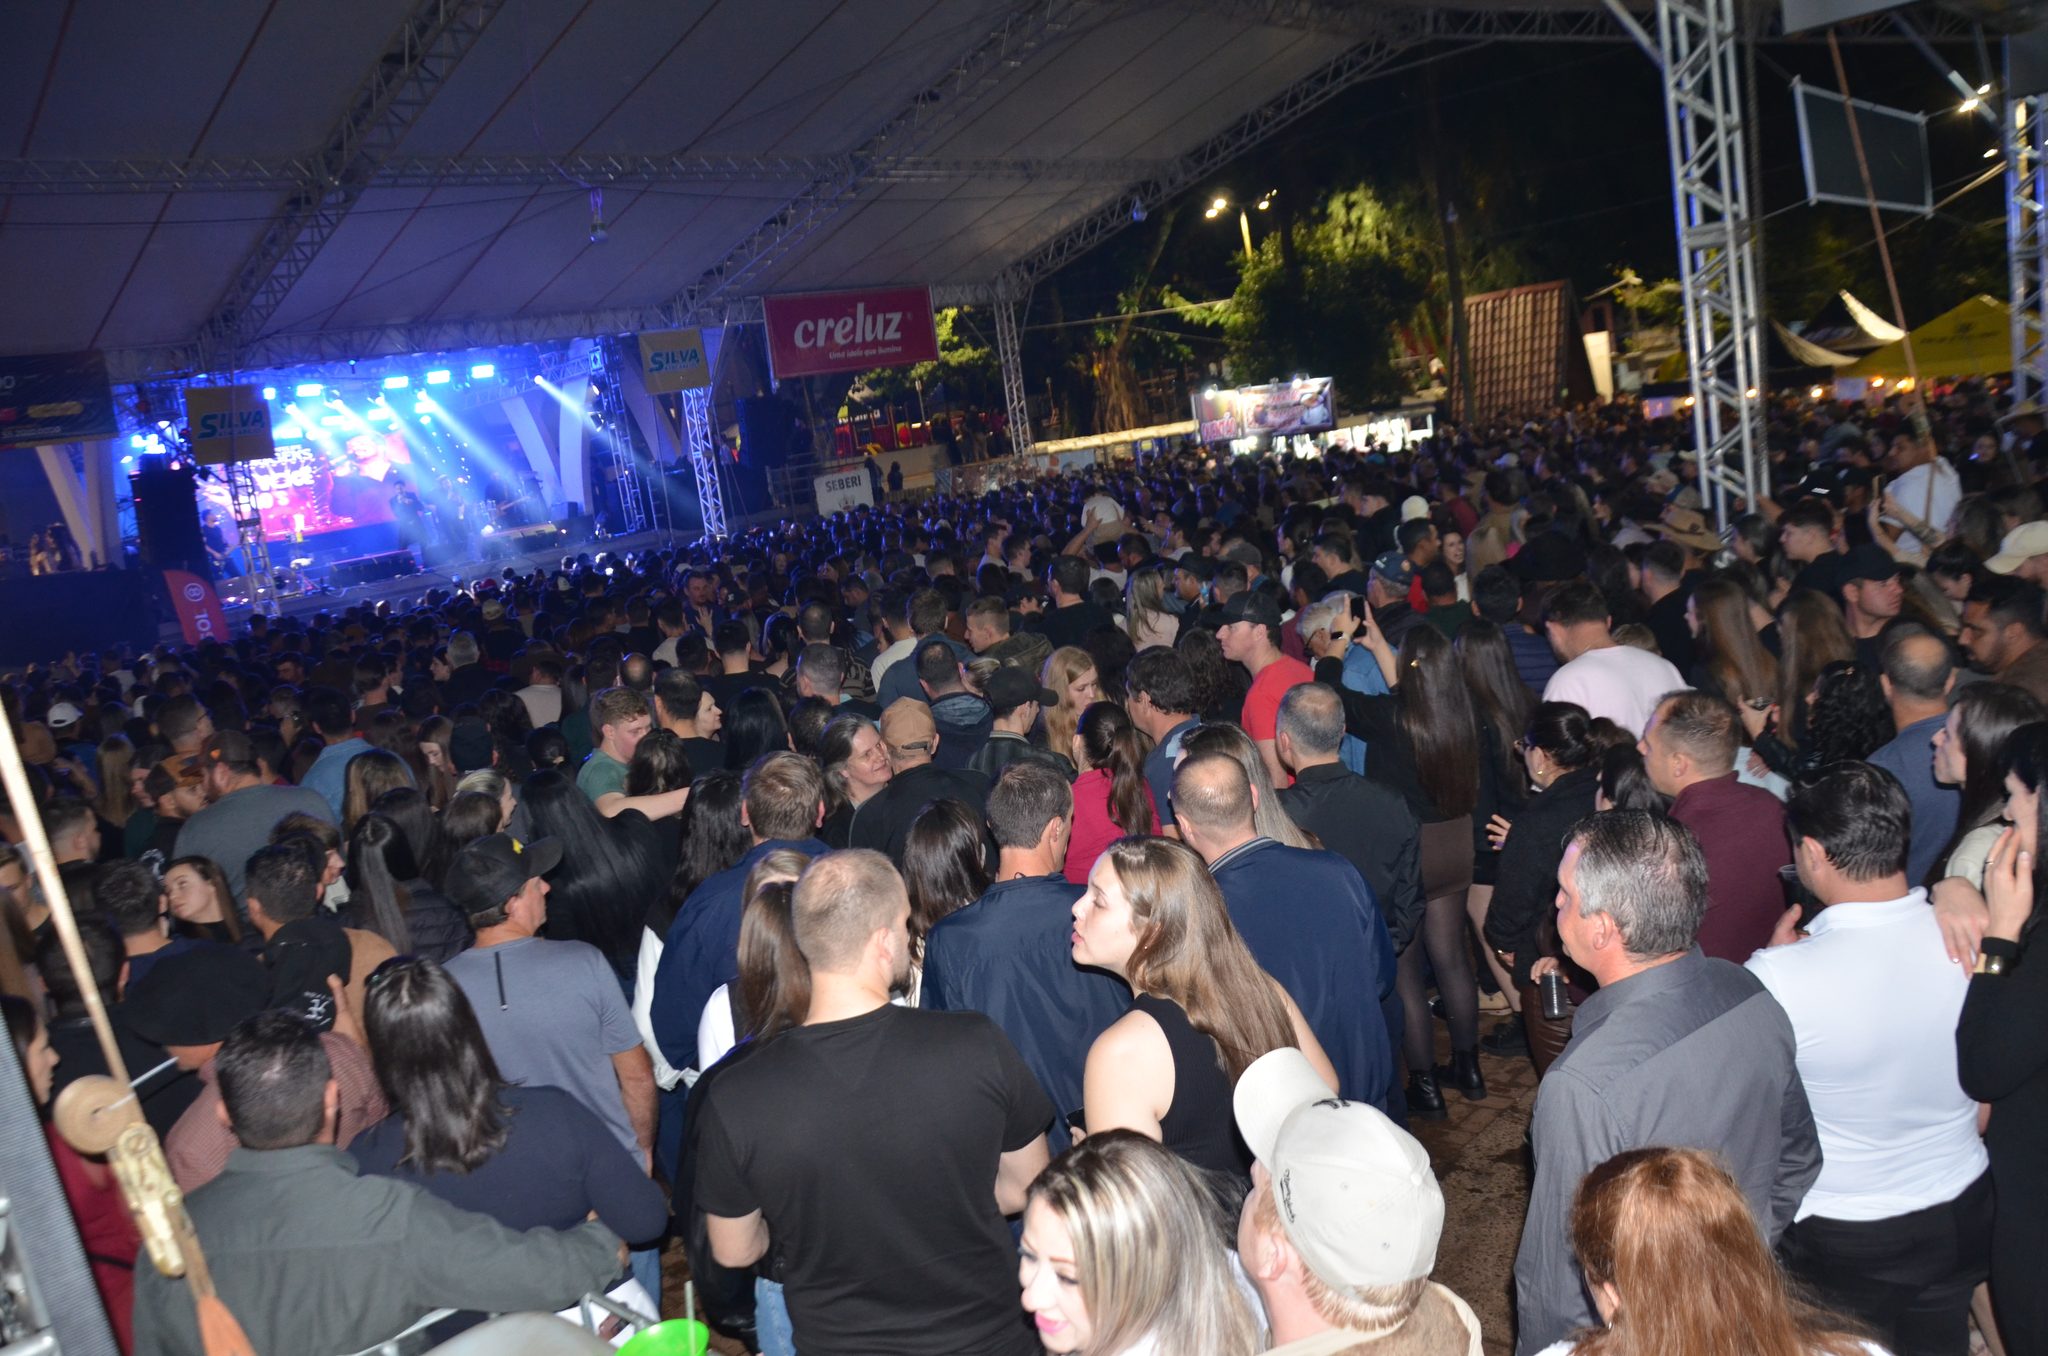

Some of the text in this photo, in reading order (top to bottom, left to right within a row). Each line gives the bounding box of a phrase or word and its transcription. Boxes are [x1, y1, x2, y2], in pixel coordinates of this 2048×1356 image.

[794, 302, 902, 348] creluz
[649, 348, 700, 373] SILVA
[198, 410, 265, 439] SILVA
[825, 475, 861, 492] SEBERI
